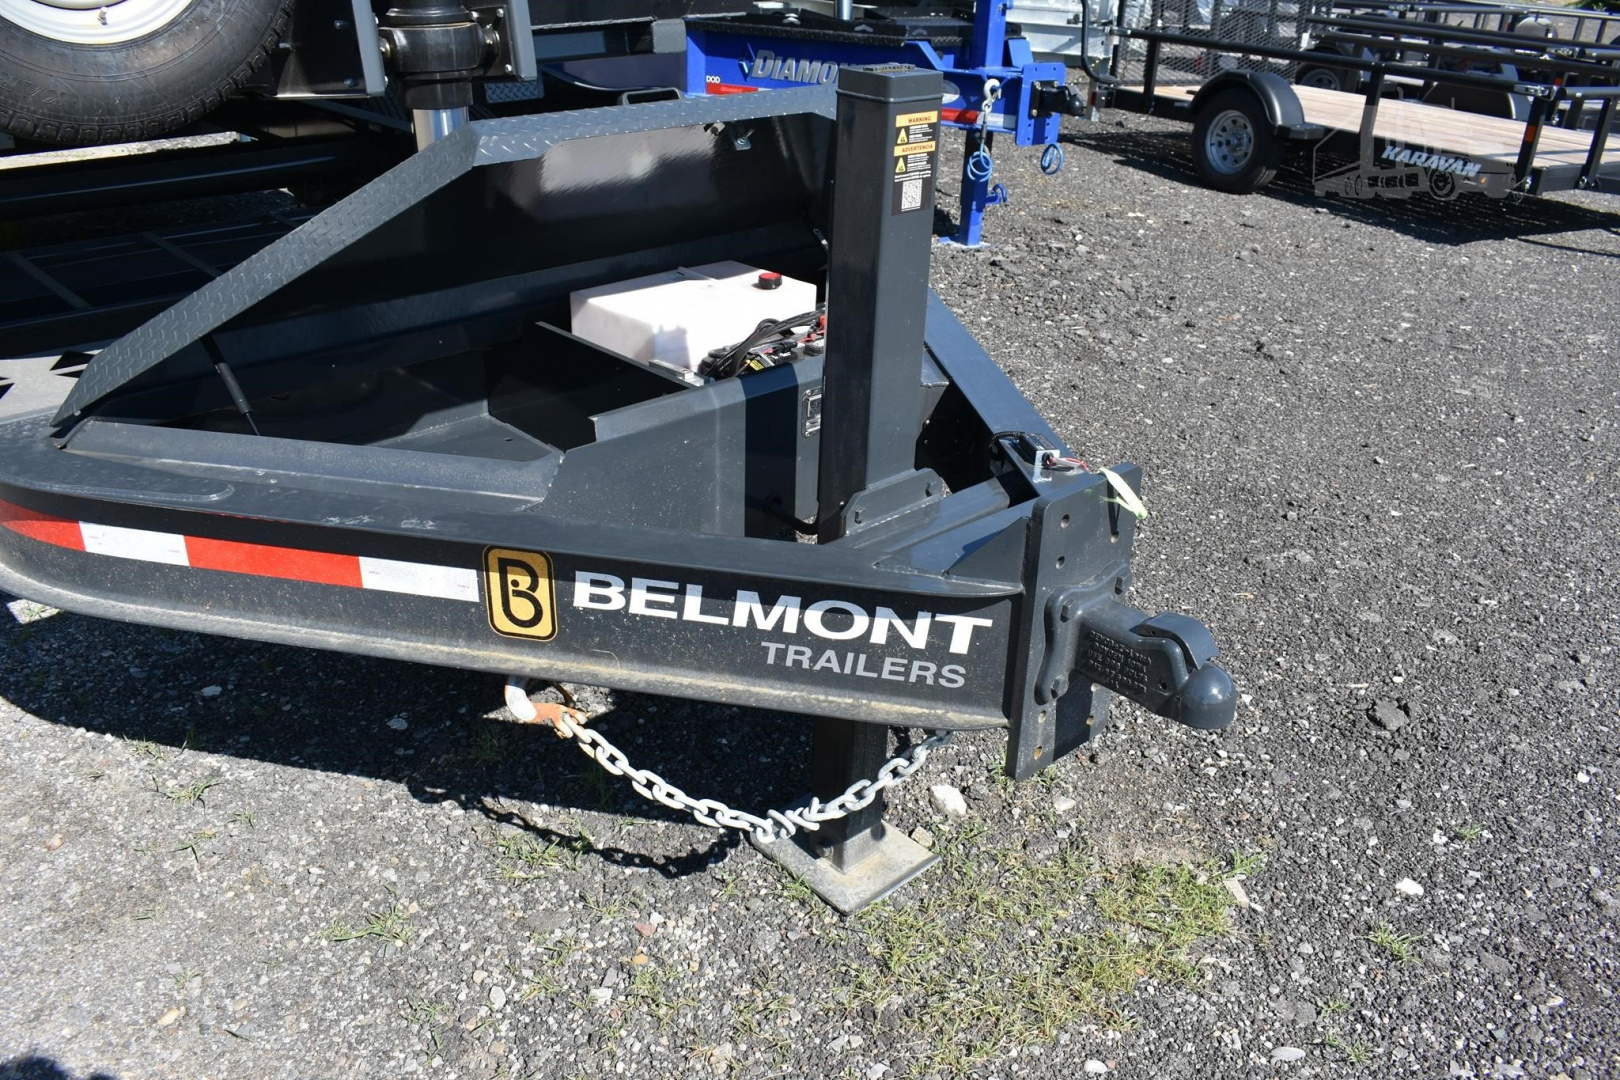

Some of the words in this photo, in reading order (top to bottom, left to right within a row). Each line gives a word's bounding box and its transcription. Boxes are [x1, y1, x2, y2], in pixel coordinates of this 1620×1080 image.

[752, 49, 846, 85] DIAMO
[901, 145, 933, 153] ADVERTENCIA
[1382, 145, 1482, 177] KARAVAN
[573, 570, 993, 655] BELMONT
[761, 641, 966, 688] TRAILERS
